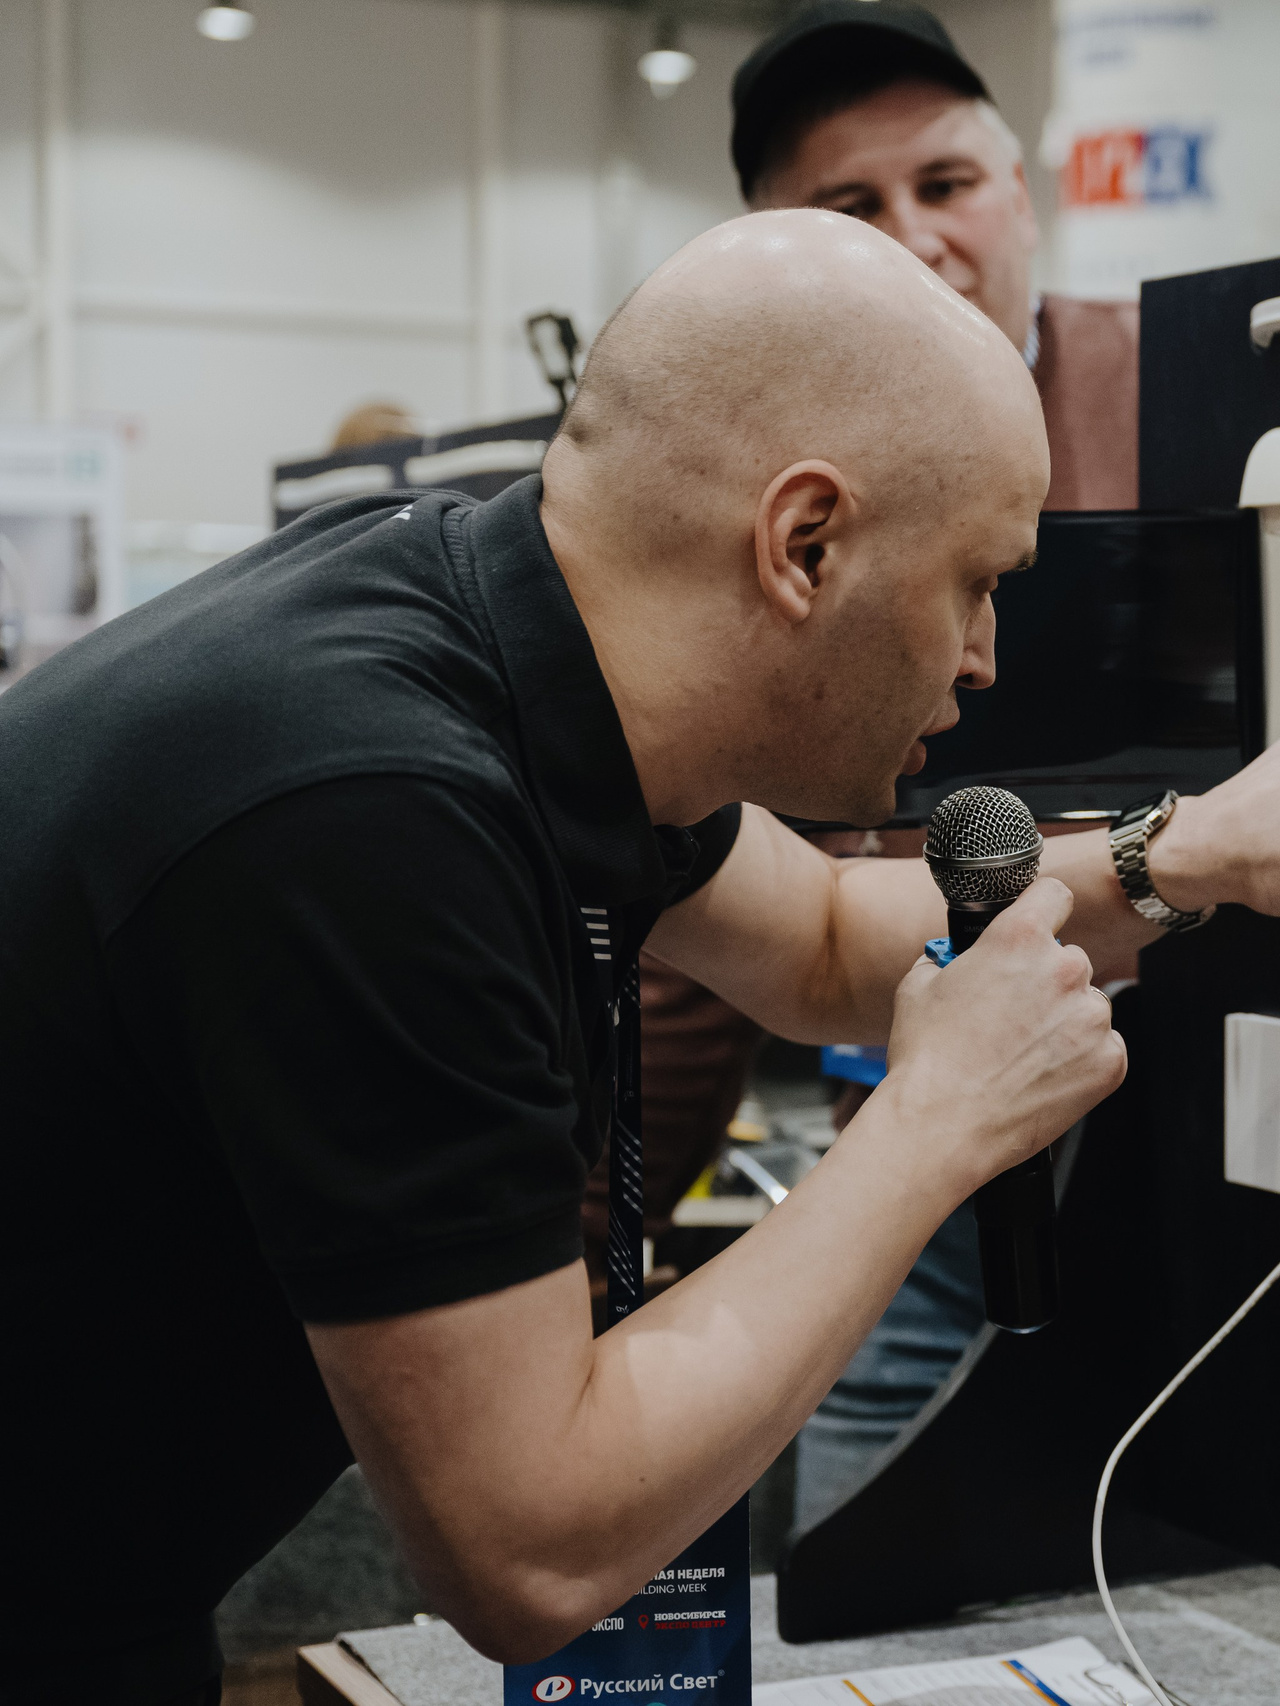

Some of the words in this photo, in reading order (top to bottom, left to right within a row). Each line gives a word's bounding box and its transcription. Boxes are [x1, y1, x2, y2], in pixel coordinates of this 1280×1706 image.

[677, 1567, 725, 1580] НЕДЕЛЯ
[677, 1583, 707, 1594] WEEK
[654, 1610, 726, 1621] НОВОСИБИРСК
[655, 1621, 690, 1630] ЭКСПО
[580, 1674, 664, 1699] Русский
